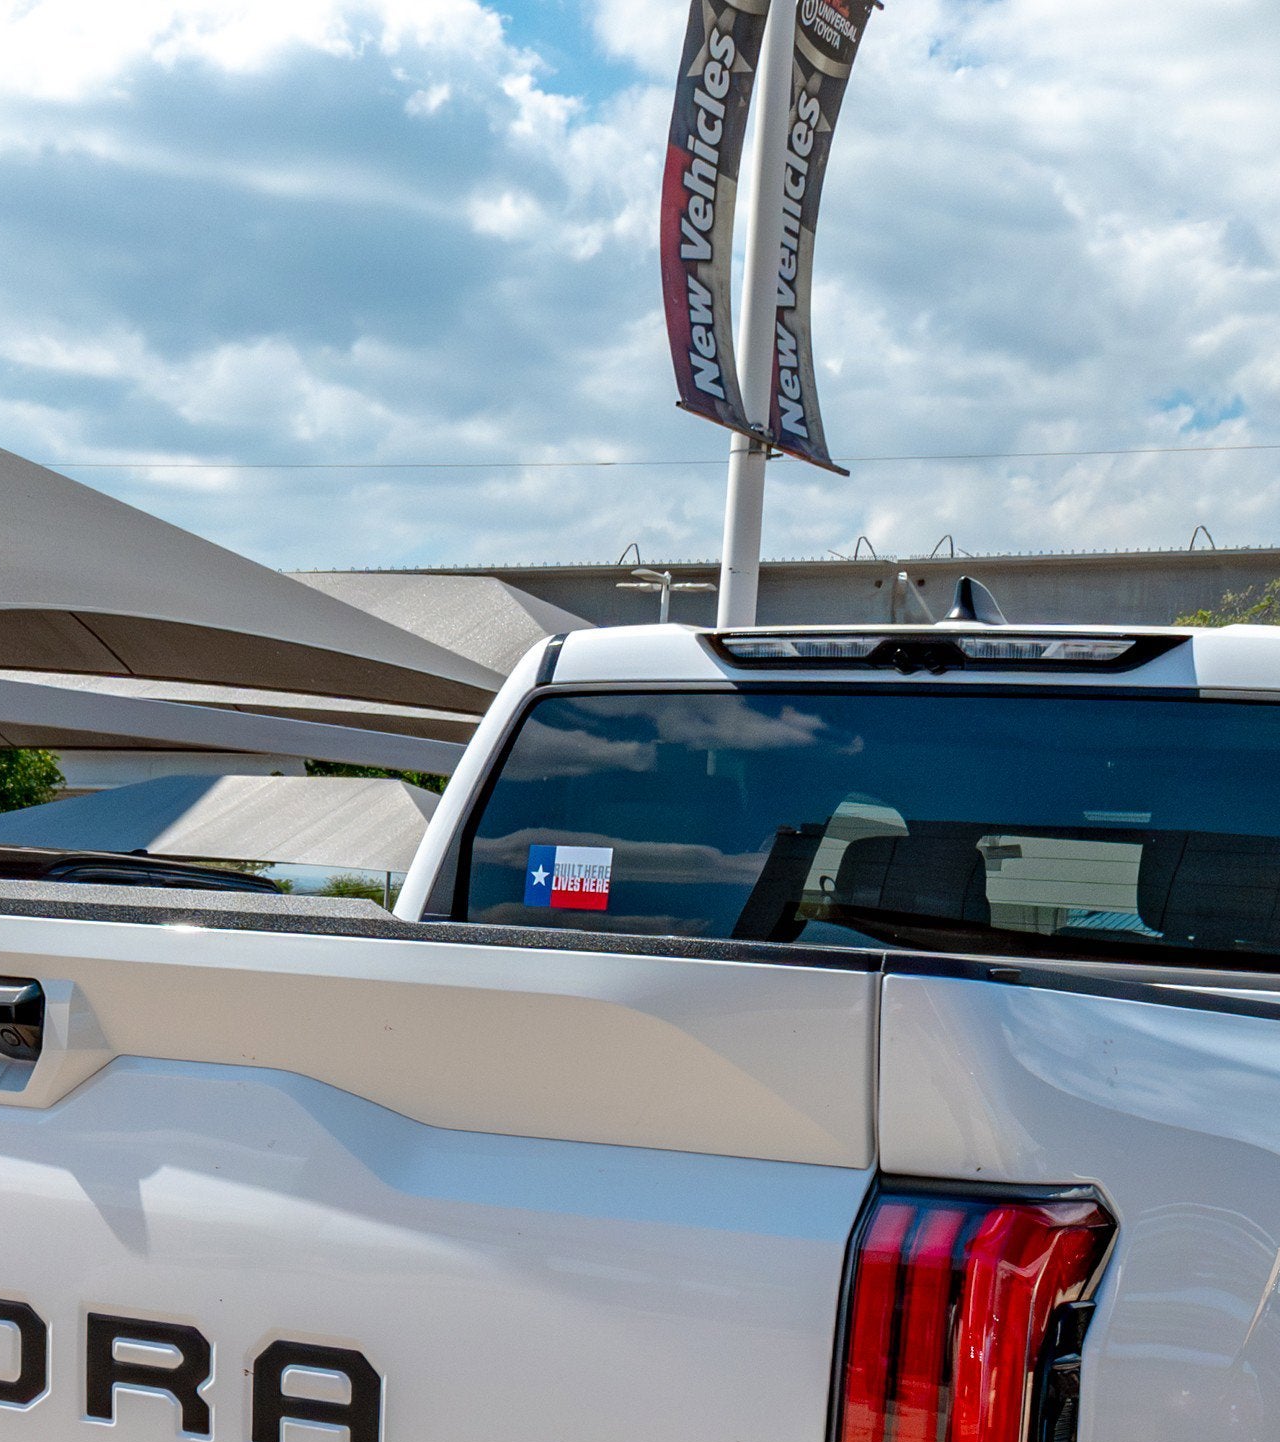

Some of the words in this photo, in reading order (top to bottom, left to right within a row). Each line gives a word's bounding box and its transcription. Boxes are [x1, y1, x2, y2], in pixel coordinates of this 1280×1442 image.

[813, 18, 841, 49] TOYOTA
[817, 3, 858, 42] UNIVERSAL
[680, 27, 736, 264] Vehicles
[688, 273, 725, 400] New
[776, 321, 809, 440] New
[552, 876, 581, 892] LIVES
[582, 878, 610, 893] HERE
[554, 862, 583, 879] BUILT
[584, 864, 610, 879] HERE
